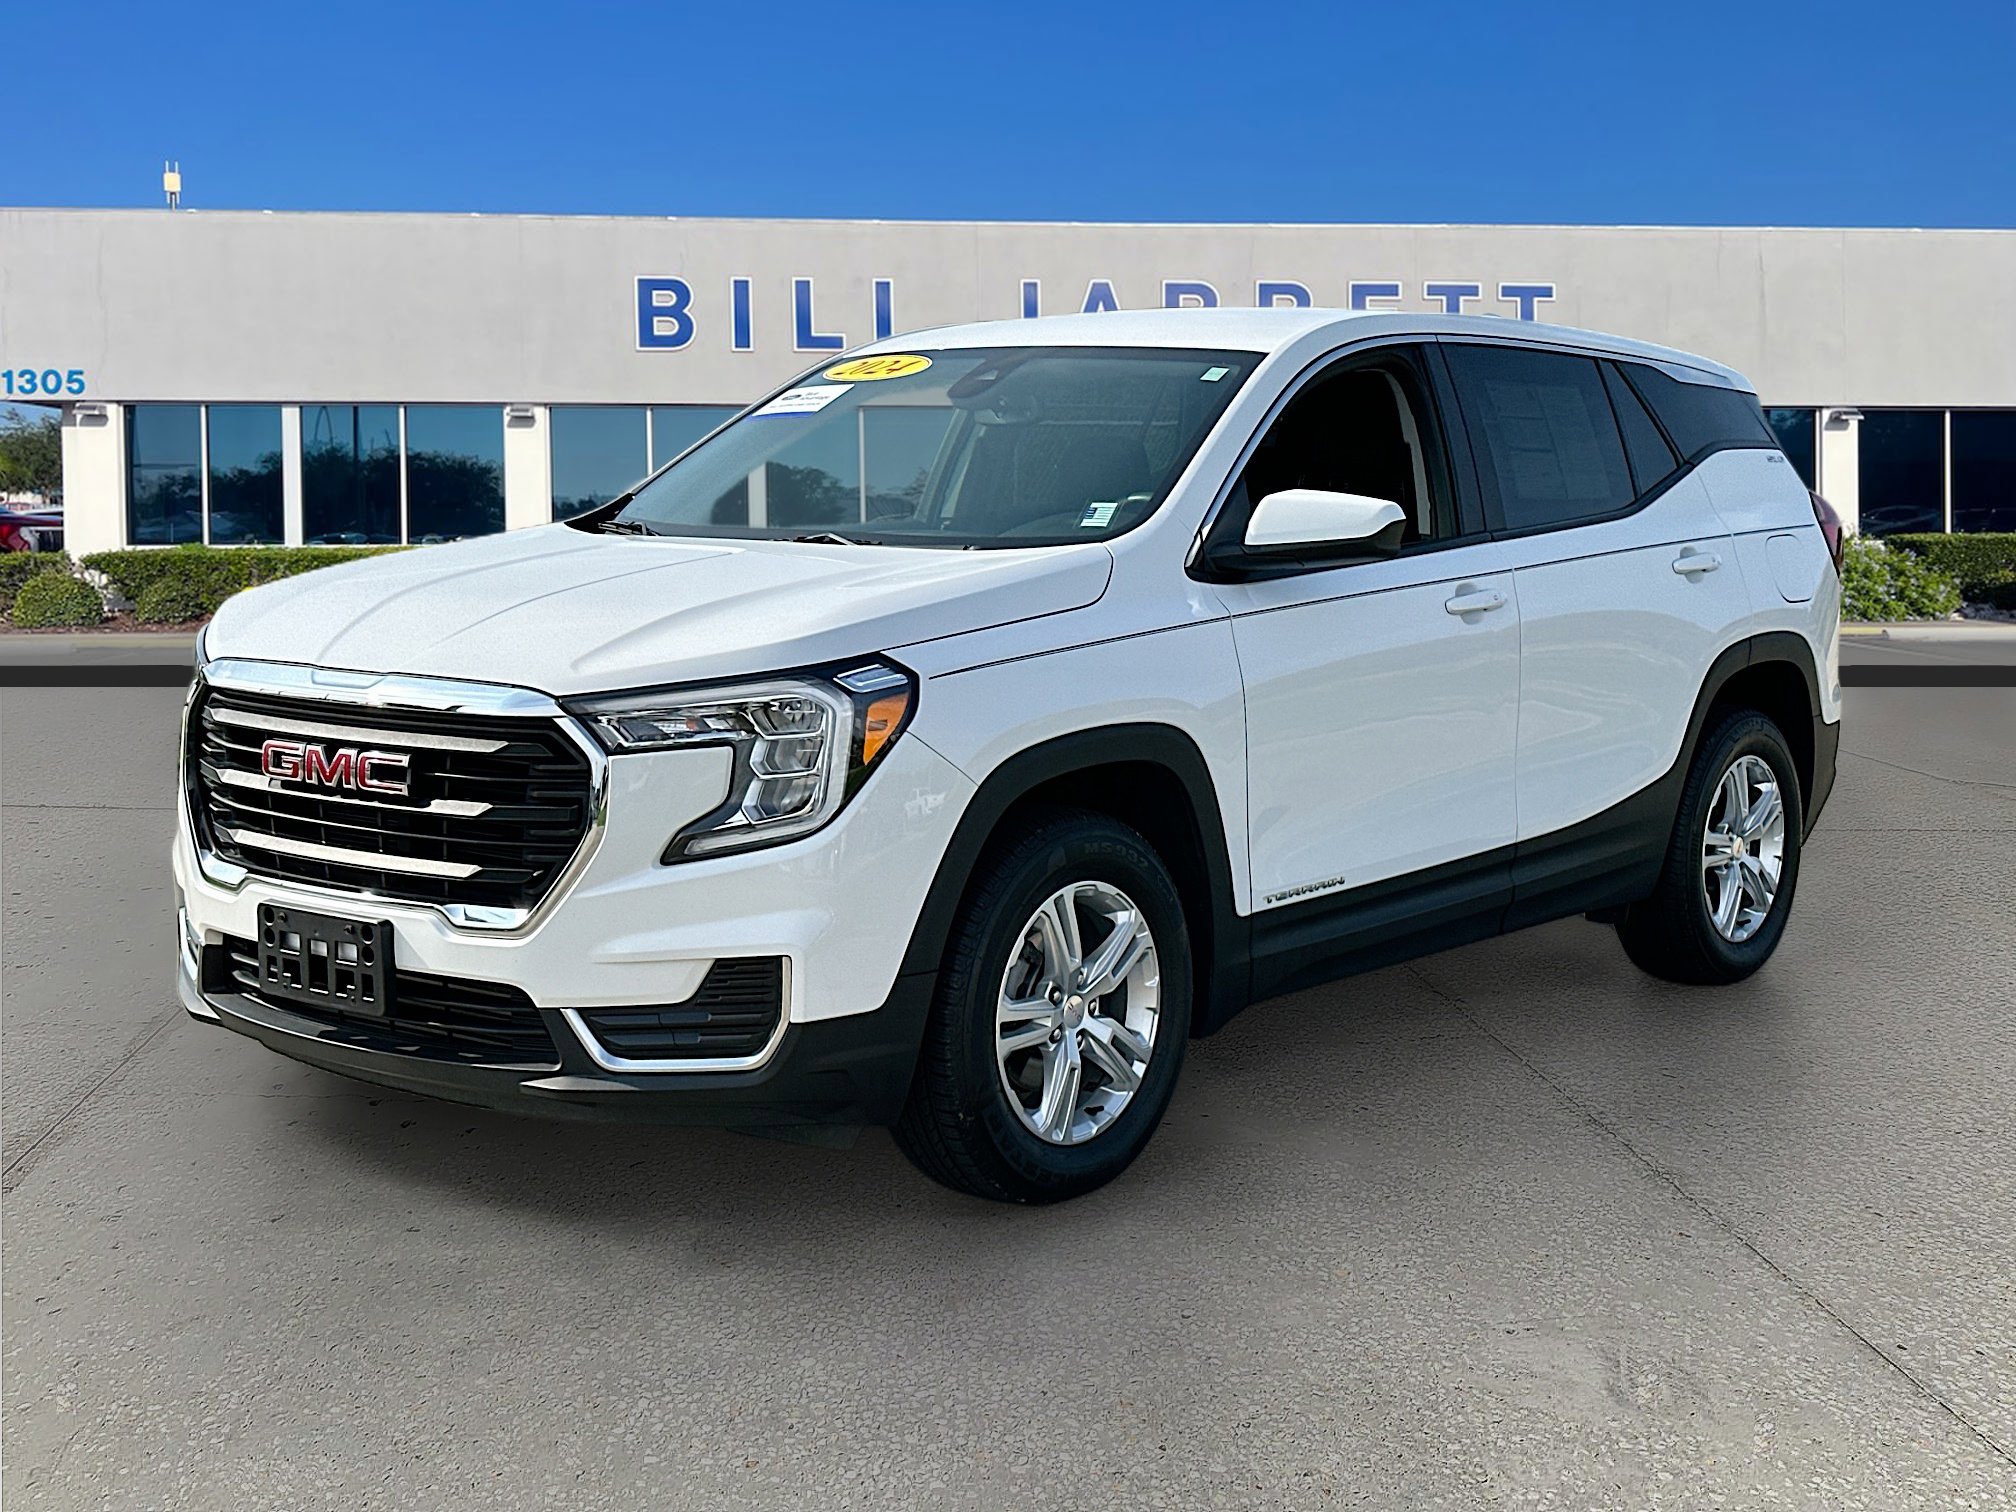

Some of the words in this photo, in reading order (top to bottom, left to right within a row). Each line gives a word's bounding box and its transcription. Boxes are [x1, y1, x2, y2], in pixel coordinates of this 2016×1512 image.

[1, 368, 86, 395] 1305
[831, 360, 920, 376] 2024
[261, 738, 412, 796] GMC
[1263, 876, 1346, 904] TERRAIN
